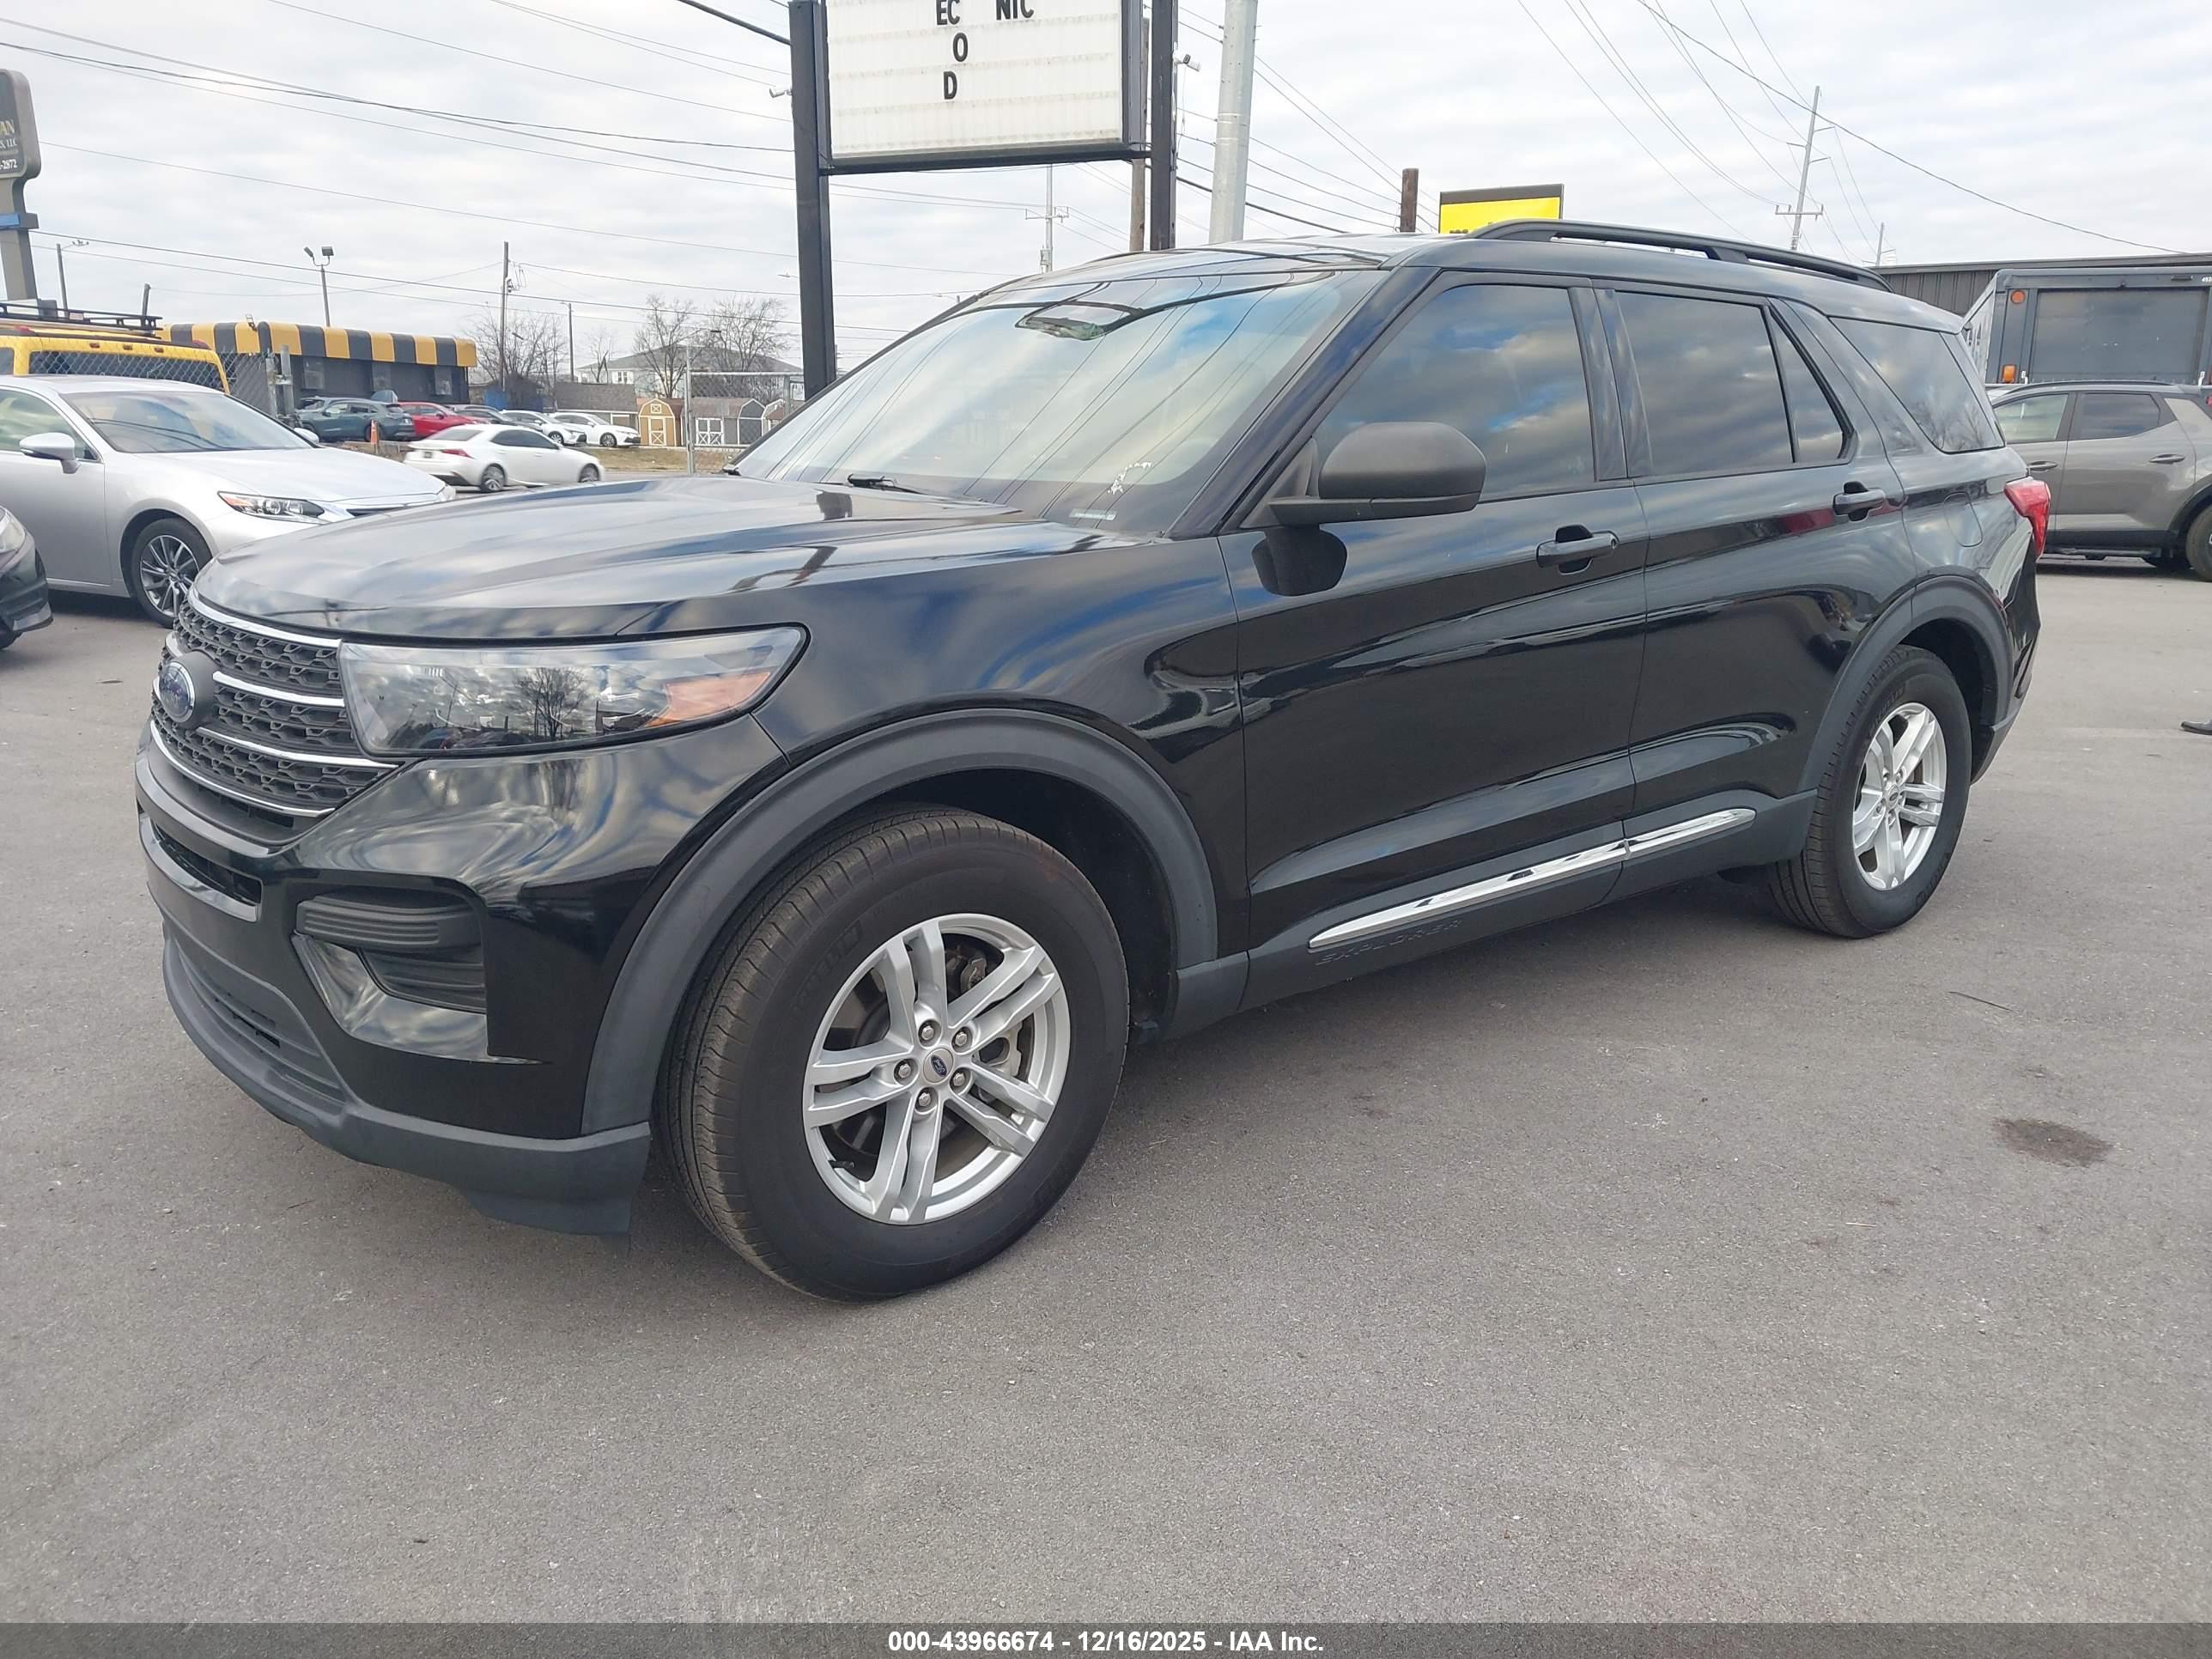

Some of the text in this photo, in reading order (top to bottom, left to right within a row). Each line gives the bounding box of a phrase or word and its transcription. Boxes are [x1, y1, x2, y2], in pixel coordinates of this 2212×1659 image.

[936, 0, 1034, 25] EC NIC
[943, 70, 957, 100] D
[1316, 920, 1462, 966] EXPLORER
